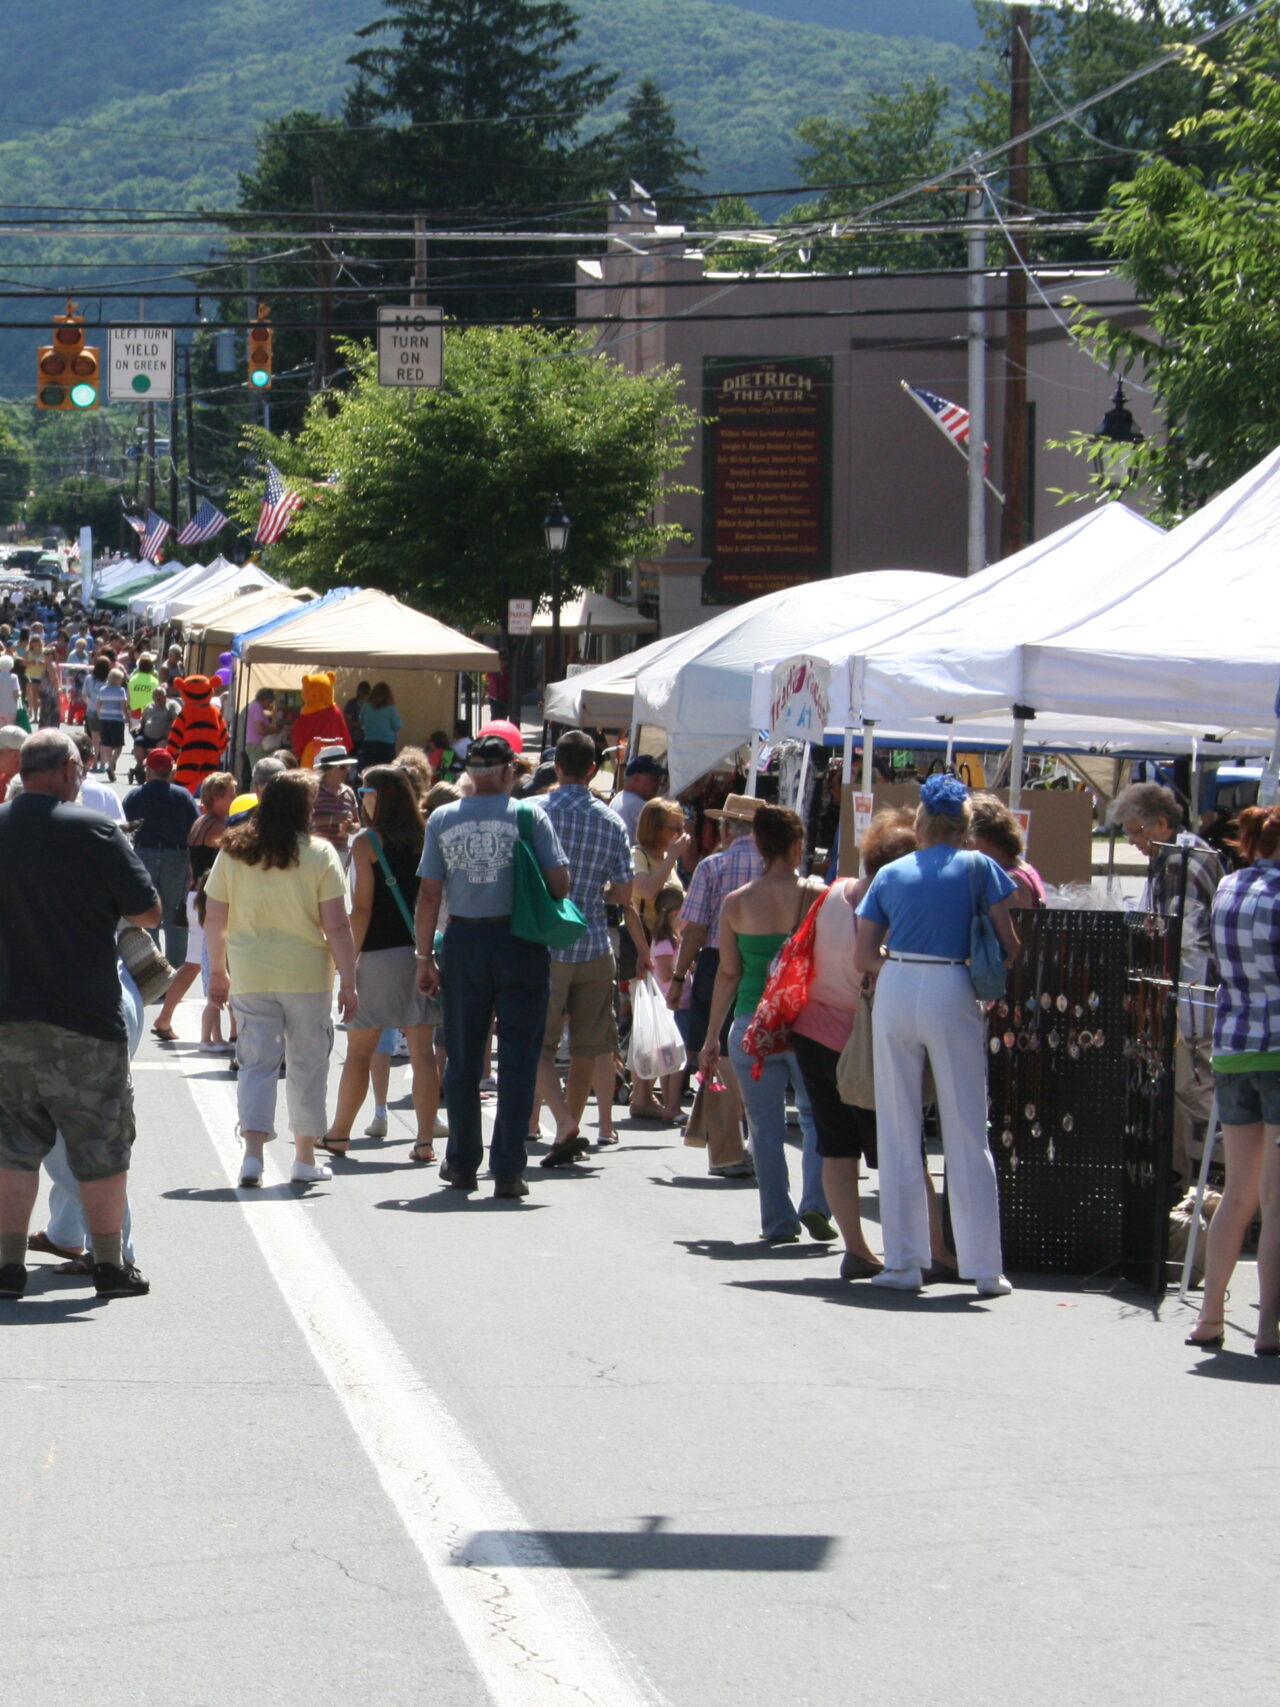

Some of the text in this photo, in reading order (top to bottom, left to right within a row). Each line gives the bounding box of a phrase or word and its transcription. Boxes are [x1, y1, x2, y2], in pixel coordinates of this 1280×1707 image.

[395, 314, 426, 332] NO
[114, 328, 168, 340] LEFT TURN
[391, 335, 429, 349] TURN
[124, 343, 159, 356] YIELD
[115, 359, 167, 371] ON GREEN
[400, 351, 420, 365] ON
[397, 367, 424, 381] RED
[722, 371, 812, 393] DIETRICH
[732, 390, 804, 401] THEATER
